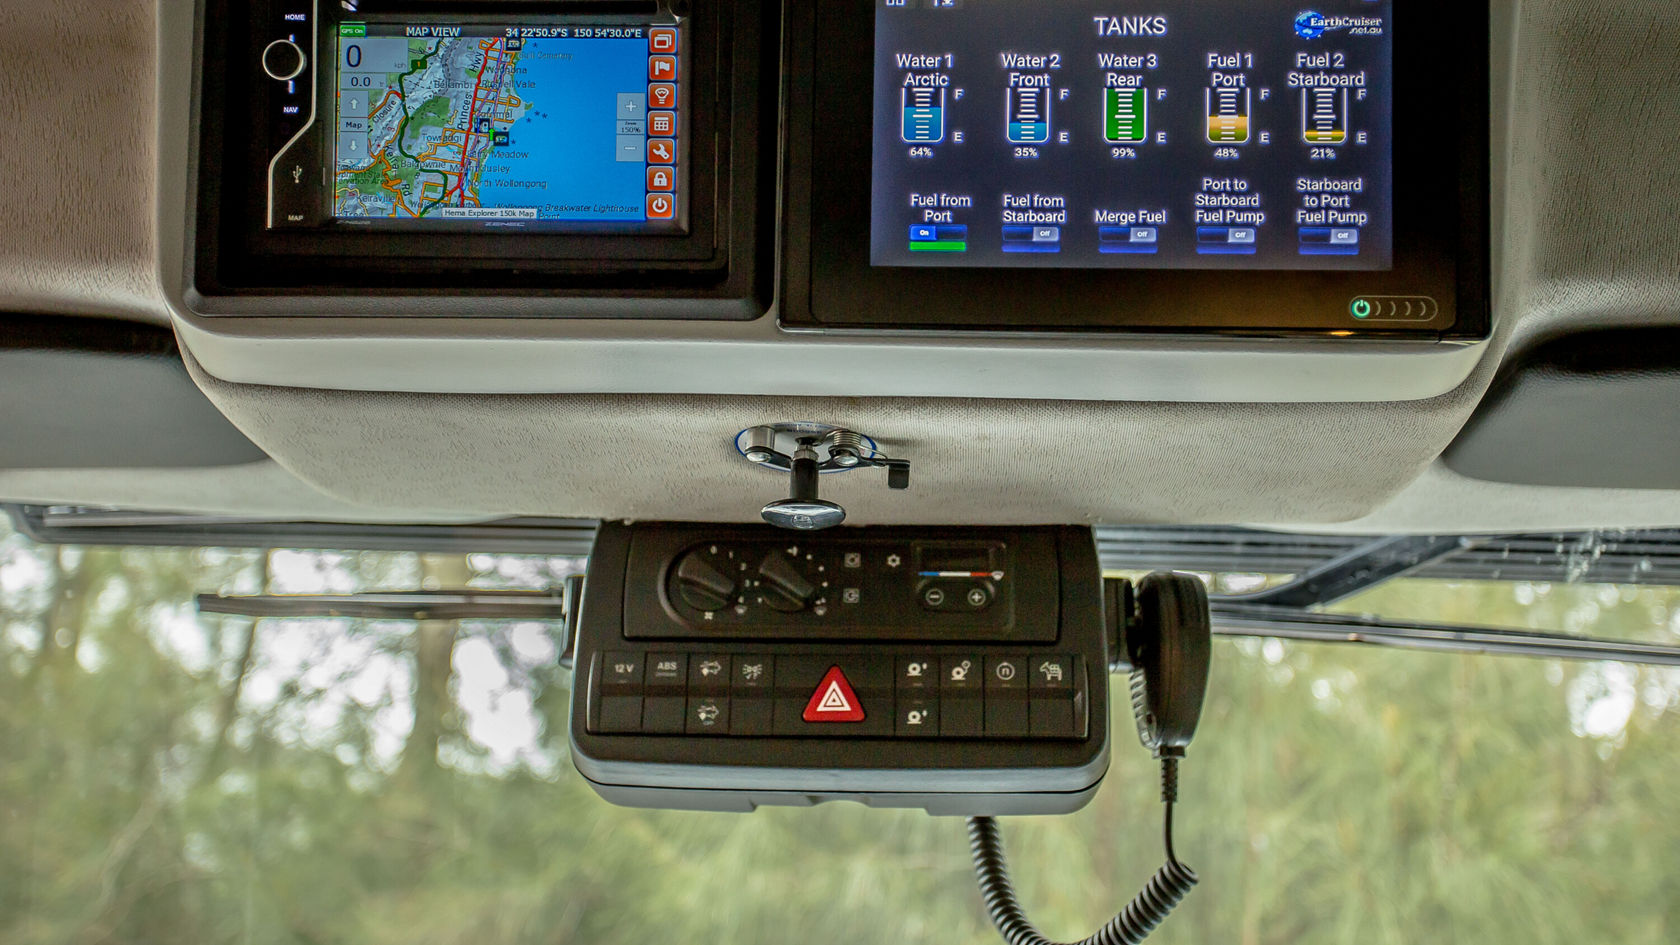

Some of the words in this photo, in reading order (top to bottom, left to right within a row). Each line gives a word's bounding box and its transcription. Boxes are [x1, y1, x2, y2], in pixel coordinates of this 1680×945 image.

[1094, 17, 1166, 35] TANKS
[1310, 17, 1382, 27] EarthCruiser
[406, 27, 429, 37] MAP
[431, 27, 460, 37] VIEW
[505, 28, 518, 37] 34
[574, 29, 593, 37] 150
[346, 45, 361, 67] 0
[897, 54, 940, 67] Water
[945, 54, 952, 67] 1
[1002, 54, 1046, 67] Water
[1050, 54, 1060, 67] 2
[1098, 54, 1143, 67] Water
[1146, 54, 1157, 67] 3
[1208, 53, 1240, 67] Fuel
[1244, 54, 1252, 67] 1
[1297, 53, 1329, 67] Fuel
[1333, 54, 1344, 67] 2
[469, 52, 485, 73] Hwy
[904, 72, 949, 86] Arctic
[1010, 72, 1050, 86] Front
[1107, 73, 1142, 86] Rear
[1212, 73, 1245, 86] Port
[1288, 72, 1365, 86] Starboard
[954, 89, 964, 99] F
[1060, 89, 1069, 99] F
[1157, 89, 1166, 99] F
[1260, 89, 1270, 99] F
[1357, 89, 1367, 99] F
[457, 93, 473, 131] Princes
[346, 121, 362, 130] Map
[953, 132, 963, 143] E
[1059, 132, 1068, 143] E
[1157, 132, 1166, 143] E
[1260, 132, 1270, 143] E
[1357, 132, 1367, 143] E
[910, 148, 932, 157] 64%
[1015, 148, 1038, 157] 35%
[1112, 148, 1135, 158] 99%
[1215, 148, 1238, 158] 48%
[1311, 148, 1335, 158] 21%
[1203, 178, 1230, 190] Port
[1234, 179, 1247, 190] to
[1297, 178, 1362, 191] Starboard
[911, 194, 937, 206] Fuel
[941, 194, 970, 206] from
[1004, 194, 1030, 207] Fuel
[1033, 194, 1064, 207] from
[1196, 193, 1259, 206] Starboard
[1304, 195, 1318, 206] to
[1321, 194, 1350, 207] Port
[468, 209, 498, 218] Explorer
[519, 210, 534, 218] Map
[925, 210, 951, 222] Port
[1003, 210, 1066, 222] Starboard
[1095, 210, 1135, 224] Merge
[1139, 210, 1166, 222] Fuel
[1196, 210, 1223, 222] Fuel
[1226, 210, 1264, 225] Pump
[1297, 210, 1325, 223] Fuel
[1328, 211, 1367, 225] Pump
[657, 662, 677, 670] ABS
